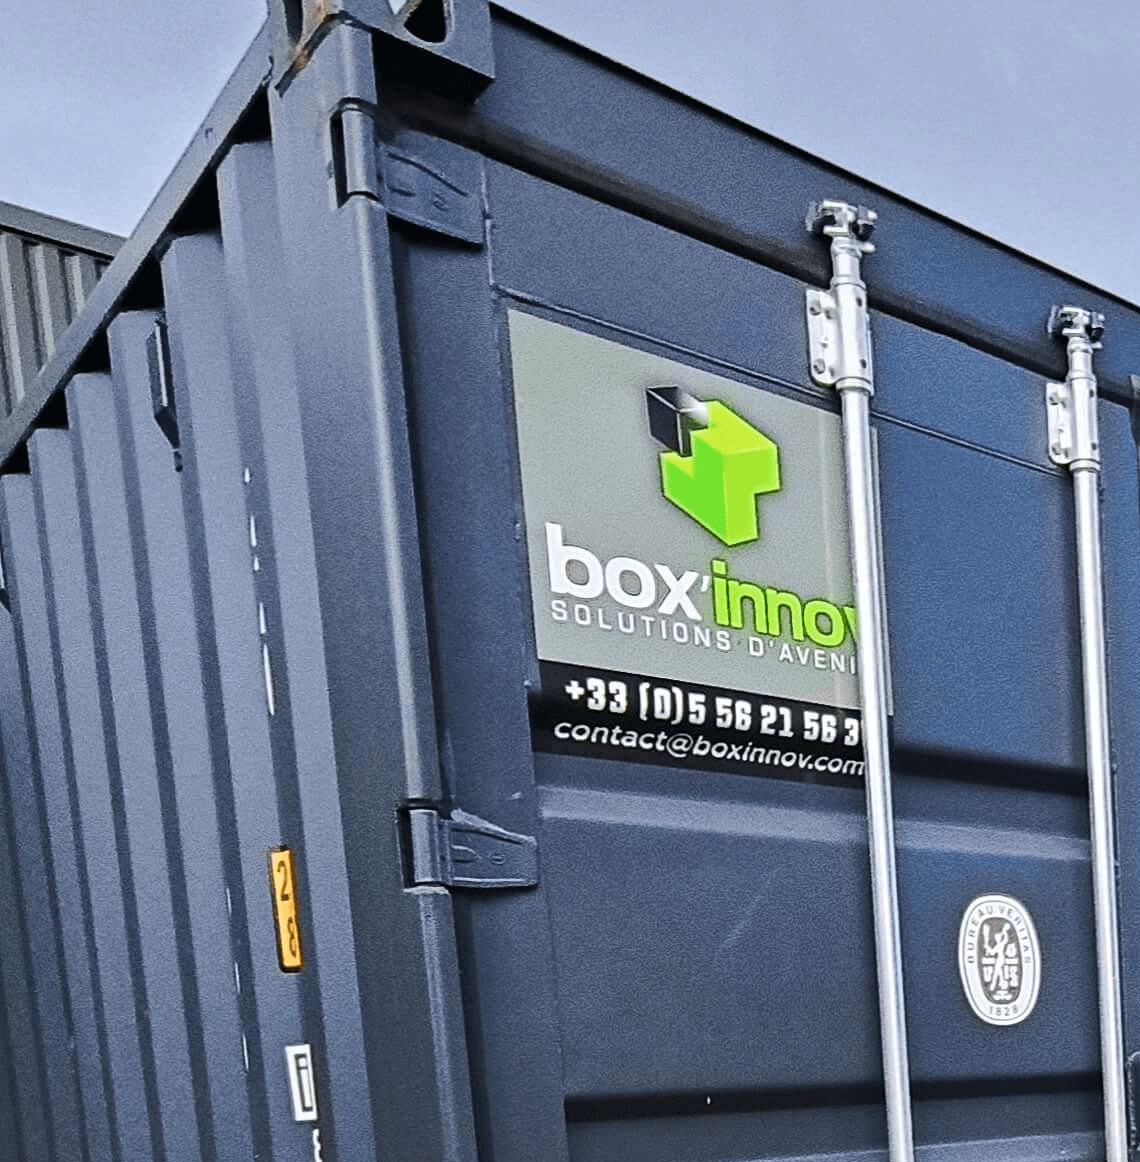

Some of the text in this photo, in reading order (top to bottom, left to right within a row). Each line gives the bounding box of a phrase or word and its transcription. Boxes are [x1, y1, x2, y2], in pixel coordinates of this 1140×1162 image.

[551, 600, 856, 674] SOLUTIONS D'AVENI
[565, 677, 864, 747] +33 (0)5 56 21 56 3
[554, 721, 865, 776] contact@boxinnov.com
